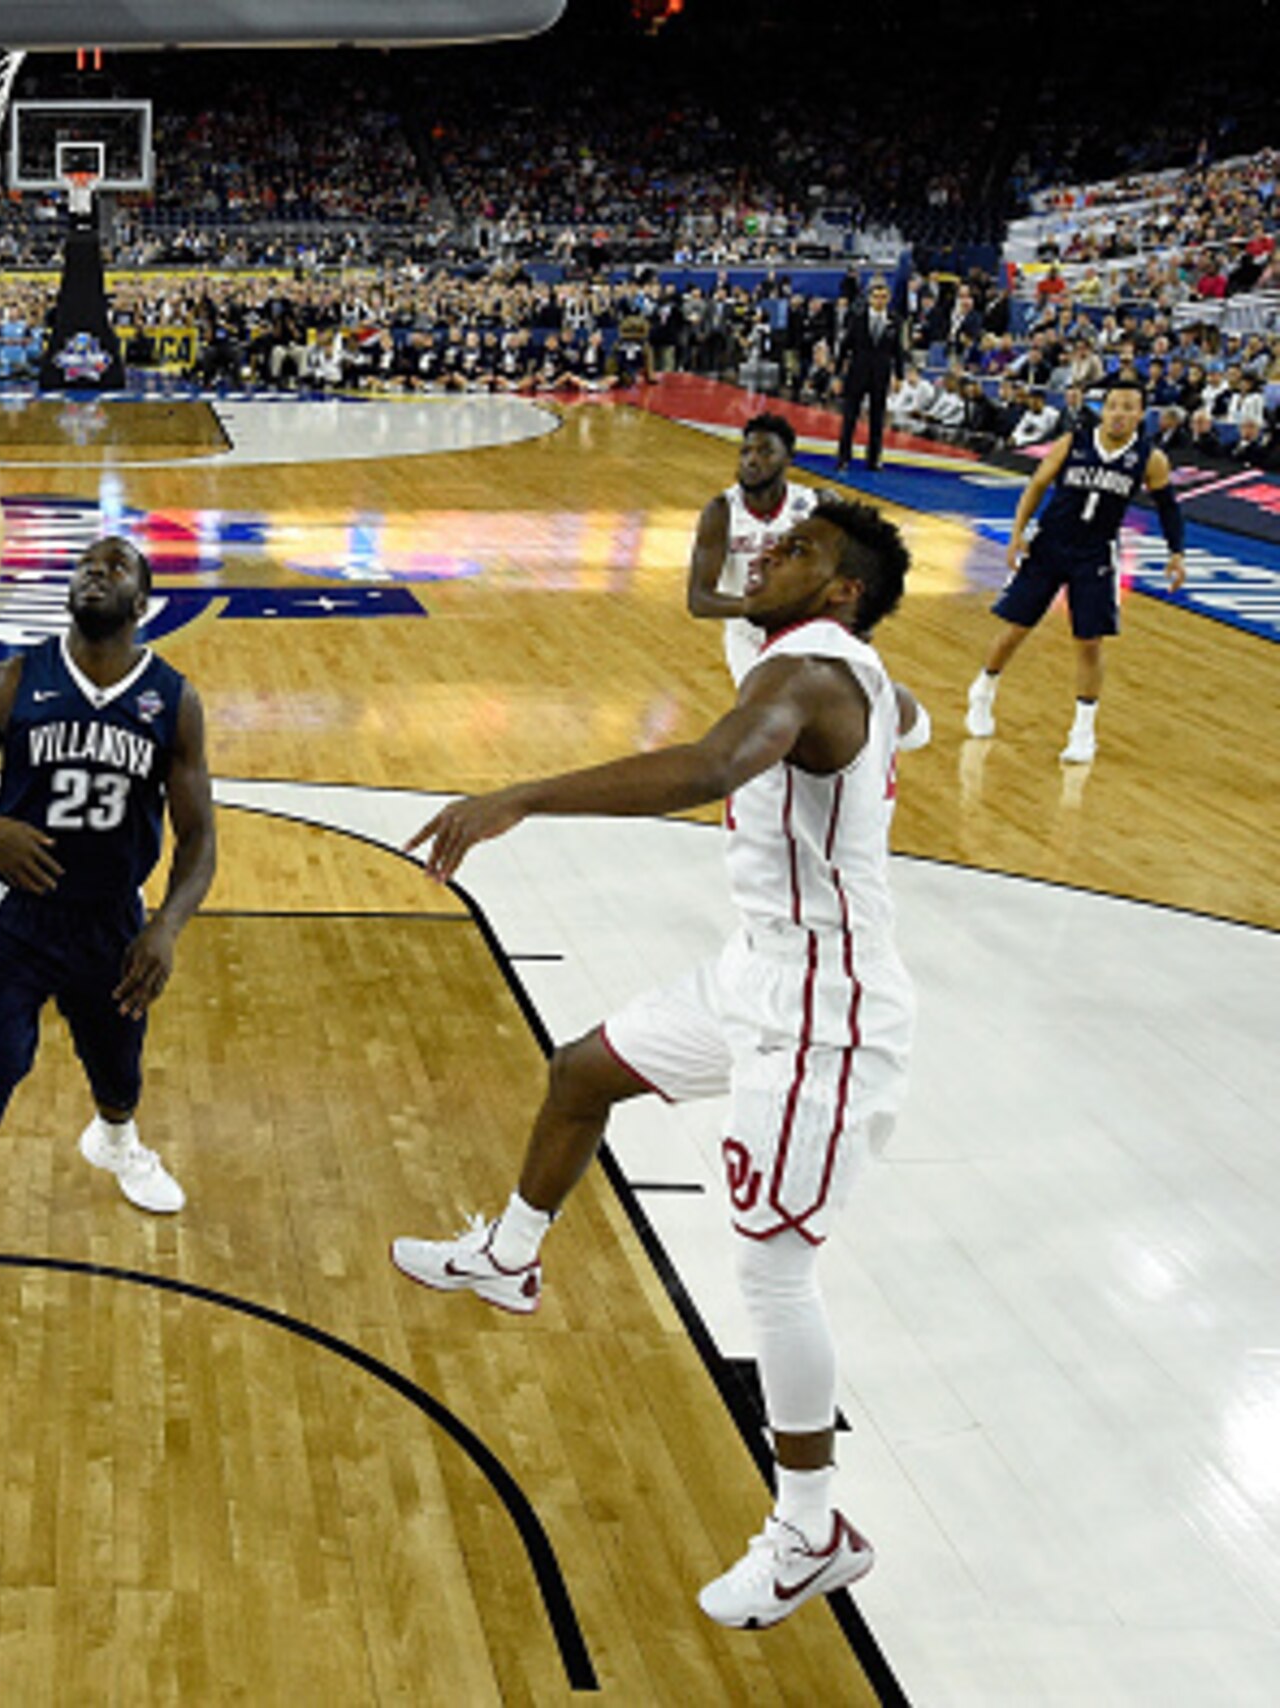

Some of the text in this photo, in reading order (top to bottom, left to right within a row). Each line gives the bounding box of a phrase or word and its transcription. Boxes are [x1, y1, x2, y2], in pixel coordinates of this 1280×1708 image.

[1081, 491, 1100, 519] 1
[29, 721, 155, 778] VILLANOVA
[46, 768, 131, 829] 23
